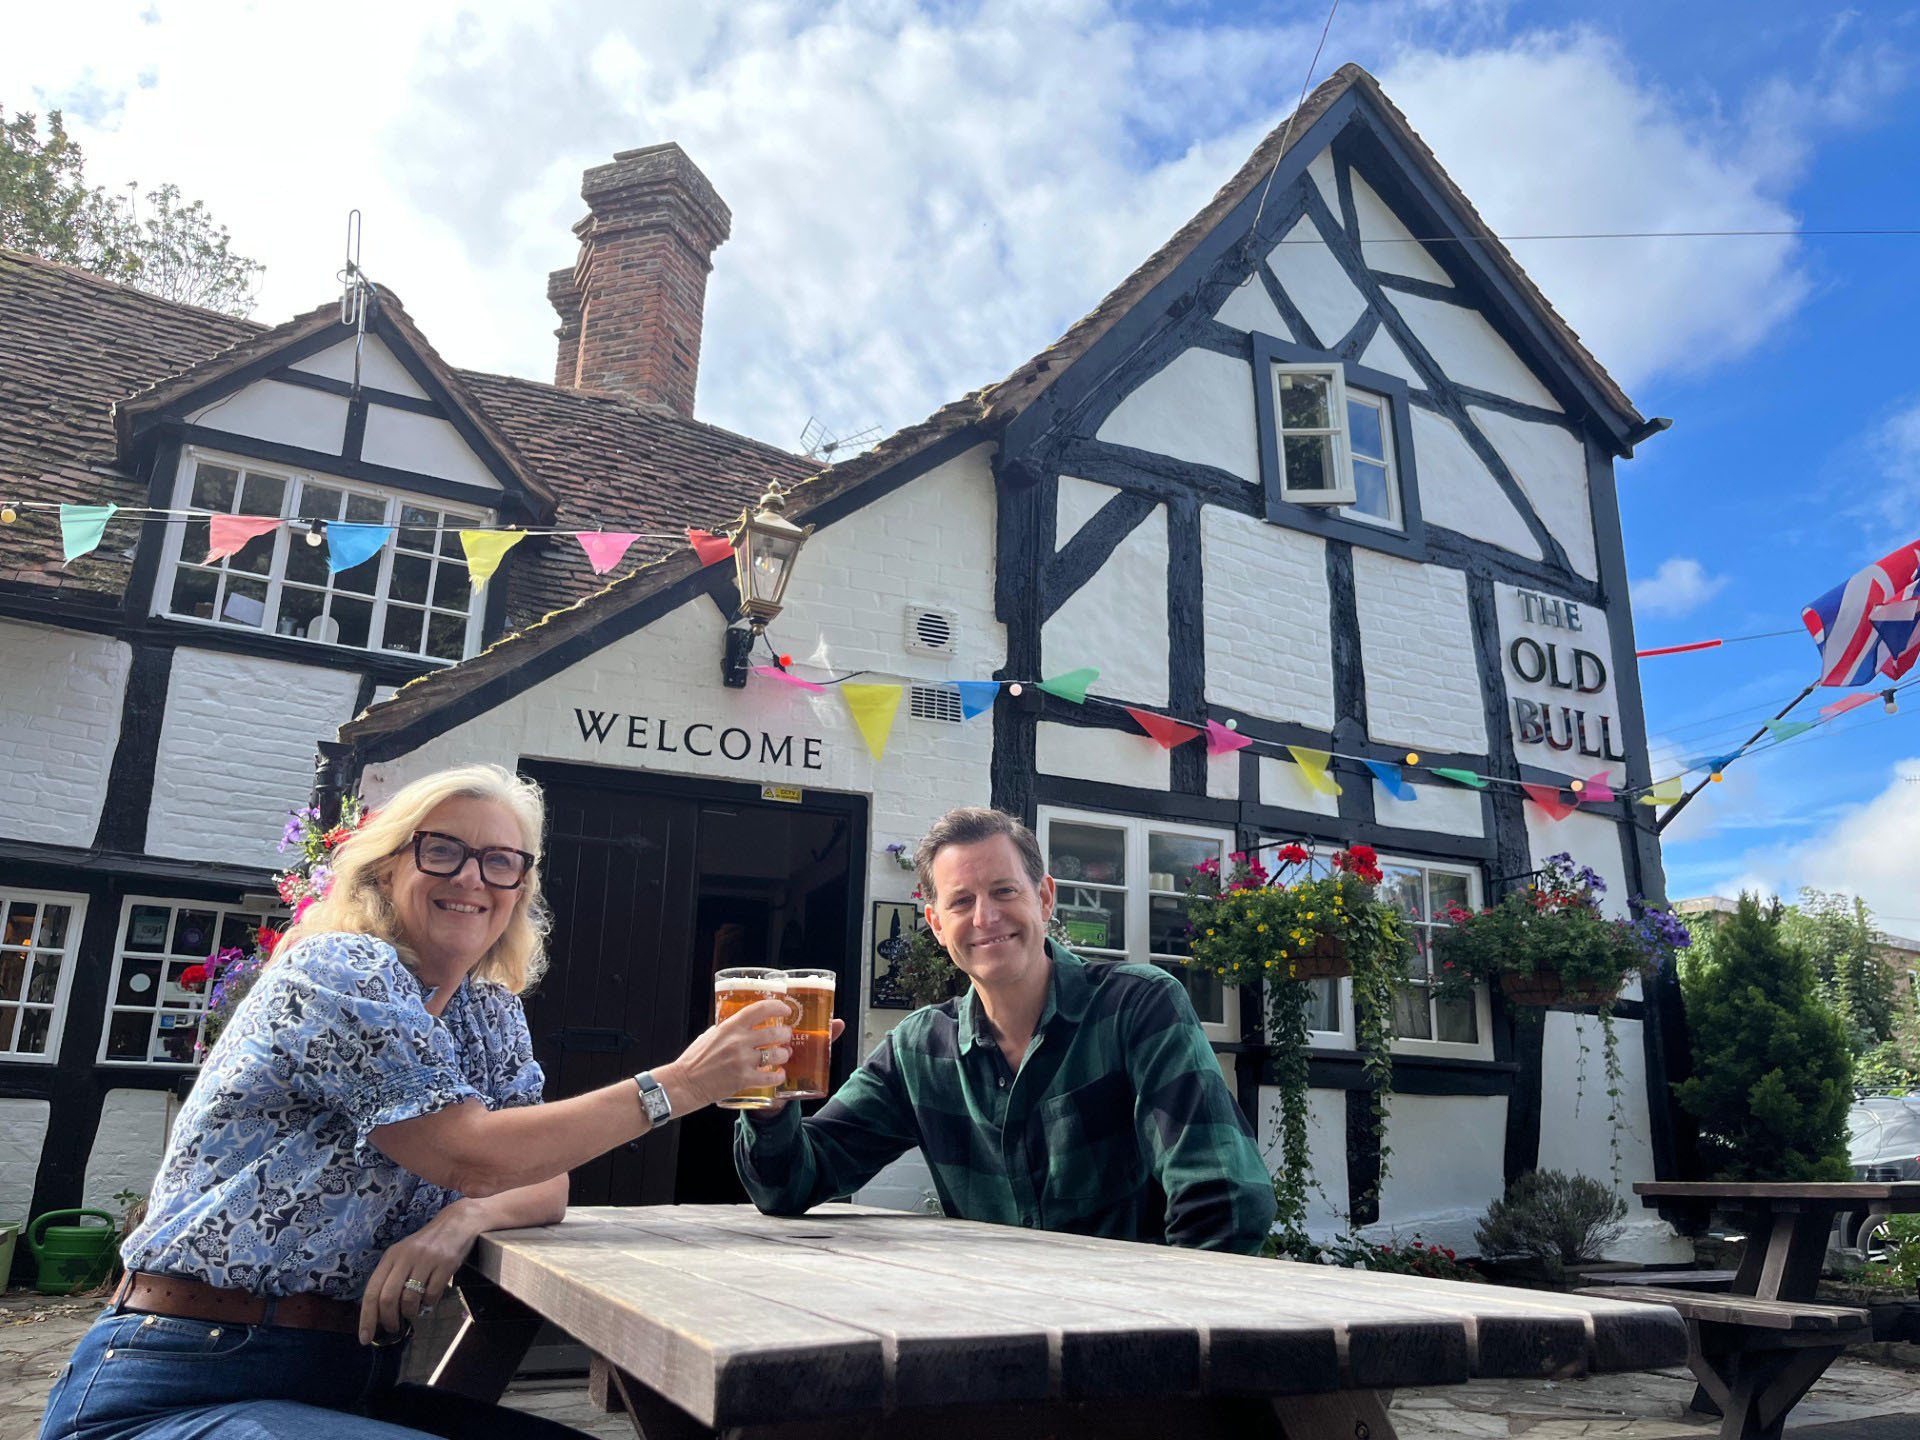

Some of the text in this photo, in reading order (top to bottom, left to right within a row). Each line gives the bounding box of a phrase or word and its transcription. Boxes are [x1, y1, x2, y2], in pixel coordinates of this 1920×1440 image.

[1517, 588, 1582, 632] THE
[1510, 637, 1607, 694] OLD
[574, 708, 823, 770] WELCOME
[1512, 697, 1626, 762] BULL
